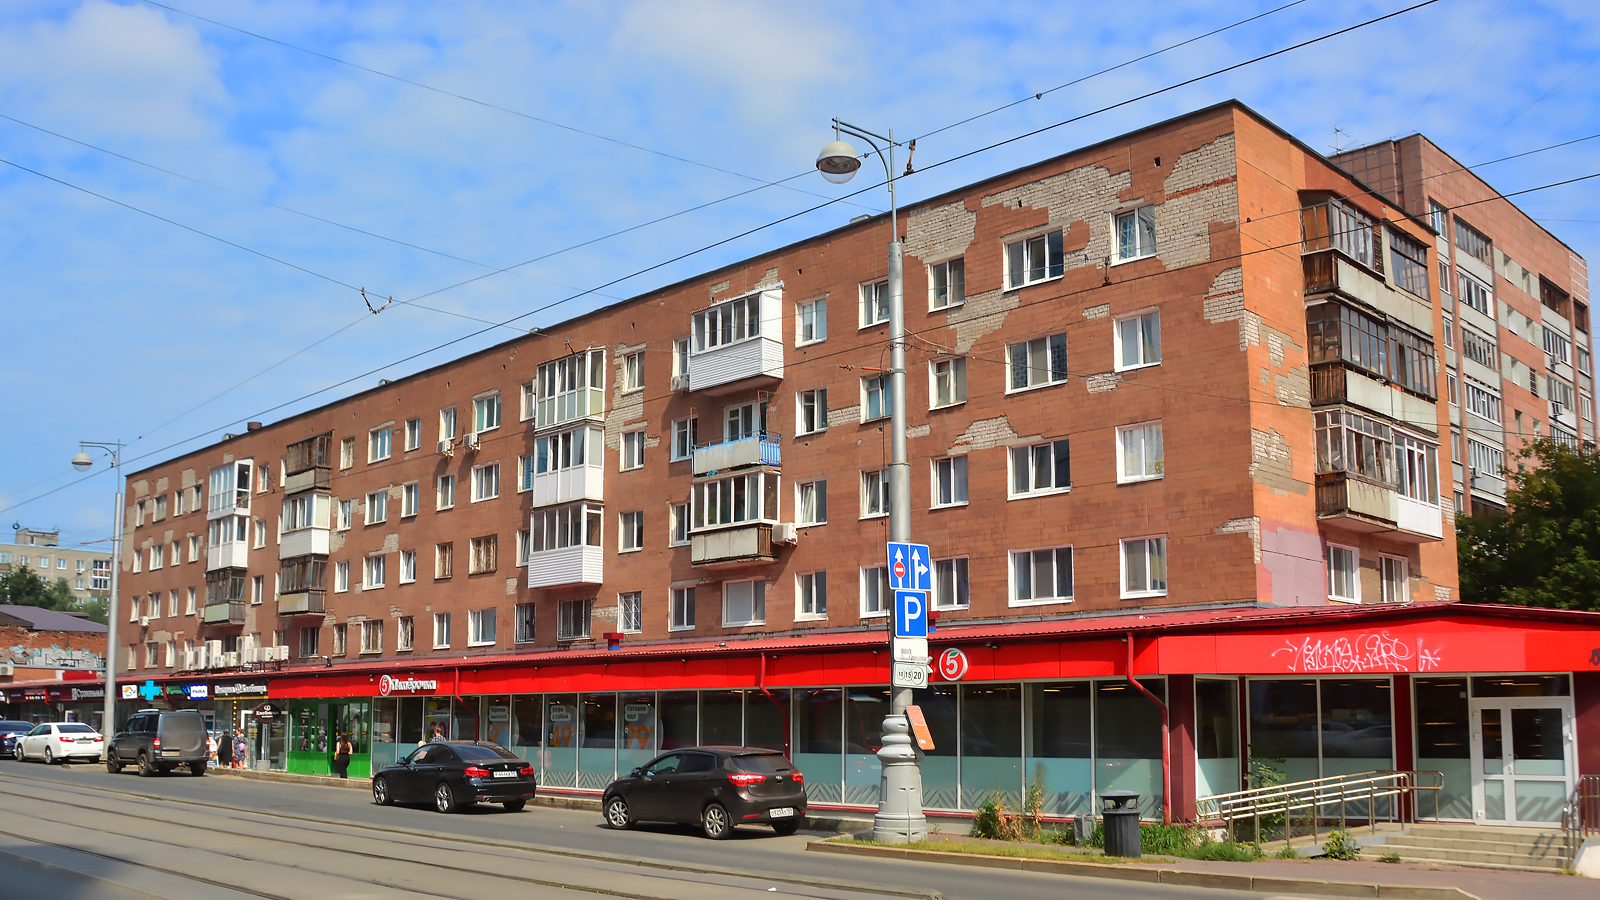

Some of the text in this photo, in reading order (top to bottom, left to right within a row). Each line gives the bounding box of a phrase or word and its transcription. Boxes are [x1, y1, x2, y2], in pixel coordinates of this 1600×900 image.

[904, 596, 921, 632] P
[913, 671, 922, 679] 20
[552, 706, 563, 714] Кофе
